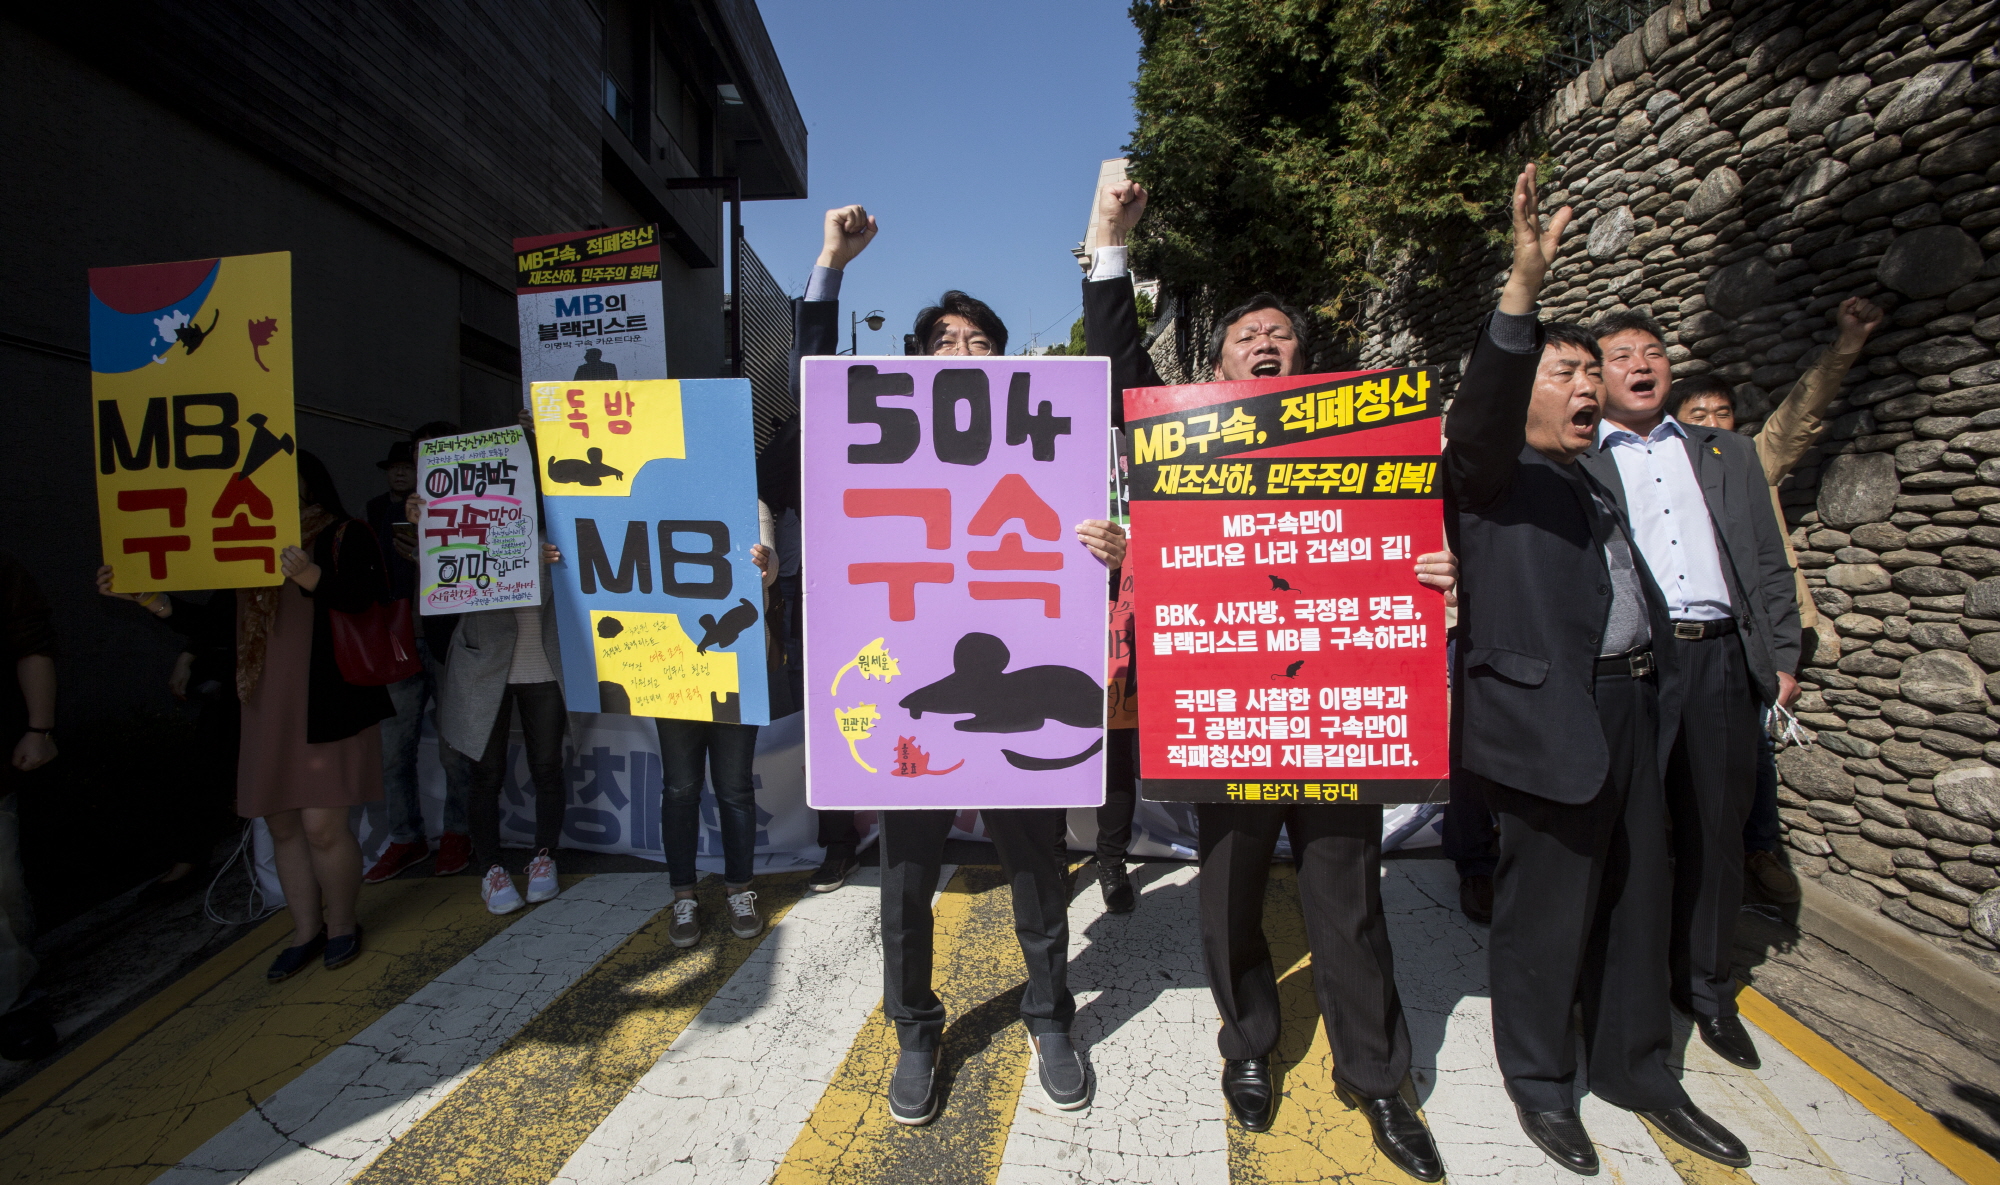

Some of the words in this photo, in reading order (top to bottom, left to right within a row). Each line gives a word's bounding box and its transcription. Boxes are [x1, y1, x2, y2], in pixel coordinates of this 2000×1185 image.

[518, 245, 581, 272] MB구속,
[586, 226, 654, 255] 적폐청산
[528, 269, 577, 285] 재조산하,
[581, 266, 626, 282] 민주주의
[630, 264, 658, 279] 회복!
[554, 294, 626, 318] MB의
[538, 315, 648, 342] 블랙리스트
[544, 341, 572, 350] 이명박
[574, 339, 593, 348] 구속
[596, 334, 642, 345] 카운트다운
[847, 364, 1071, 466] 504
[1134, 407, 1267, 465] MB구속,
[1279, 370, 1431, 434] 적폐청산
[98, 392, 241, 475] MB
[425, 459, 518, 498] 이명박
[1153, 463, 1257, 496] 재조산하,
[1266, 462, 1368, 494] 민주주의
[1373, 462, 1437, 494] 회복!
[117, 472, 276, 580] 구속
[1222, 509, 1343, 538] MB구속만이
[574, 518, 733, 600] MB
[843, 474, 1064, 621] 구속
[1161, 544, 1245, 570] 나라다운
[1254, 540, 1298, 566] 나라
[1306, 537, 1372, 563] 건설의
[1380, 535, 1411, 560] 길!
[437, 551, 530, 589] 희망입니다
[1155, 603, 1206, 627] BBK,
[1213, 600, 1285, 626] 사자방,
[1293, 597, 1360, 623] 국정원
[1369, 595, 1422, 621] 댓글,
[1152, 630, 1258, 656] 블랙리스트
[1266, 627, 1321, 652] MB를
[1330, 625, 1427, 650] 구속하라!
[1174, 688, 1237, 713] 국민을
[1245, 687, 1311, 712] 사찰한
[1319, 686, 1408, 711] 이명박과
[841, 717, 869, 732] 김관진
[1176, 717, 1197, 739] 그
[1204, 716, 1311, 740] 공범자들의
[1320, 714, 1407, 739] 구속만이
[1281, 743, 1419, 768] 지름길입니다.
[1226, 783, 1299, 801] 쥐를잡자
[1303, 783, 1359, 801] 특공대
